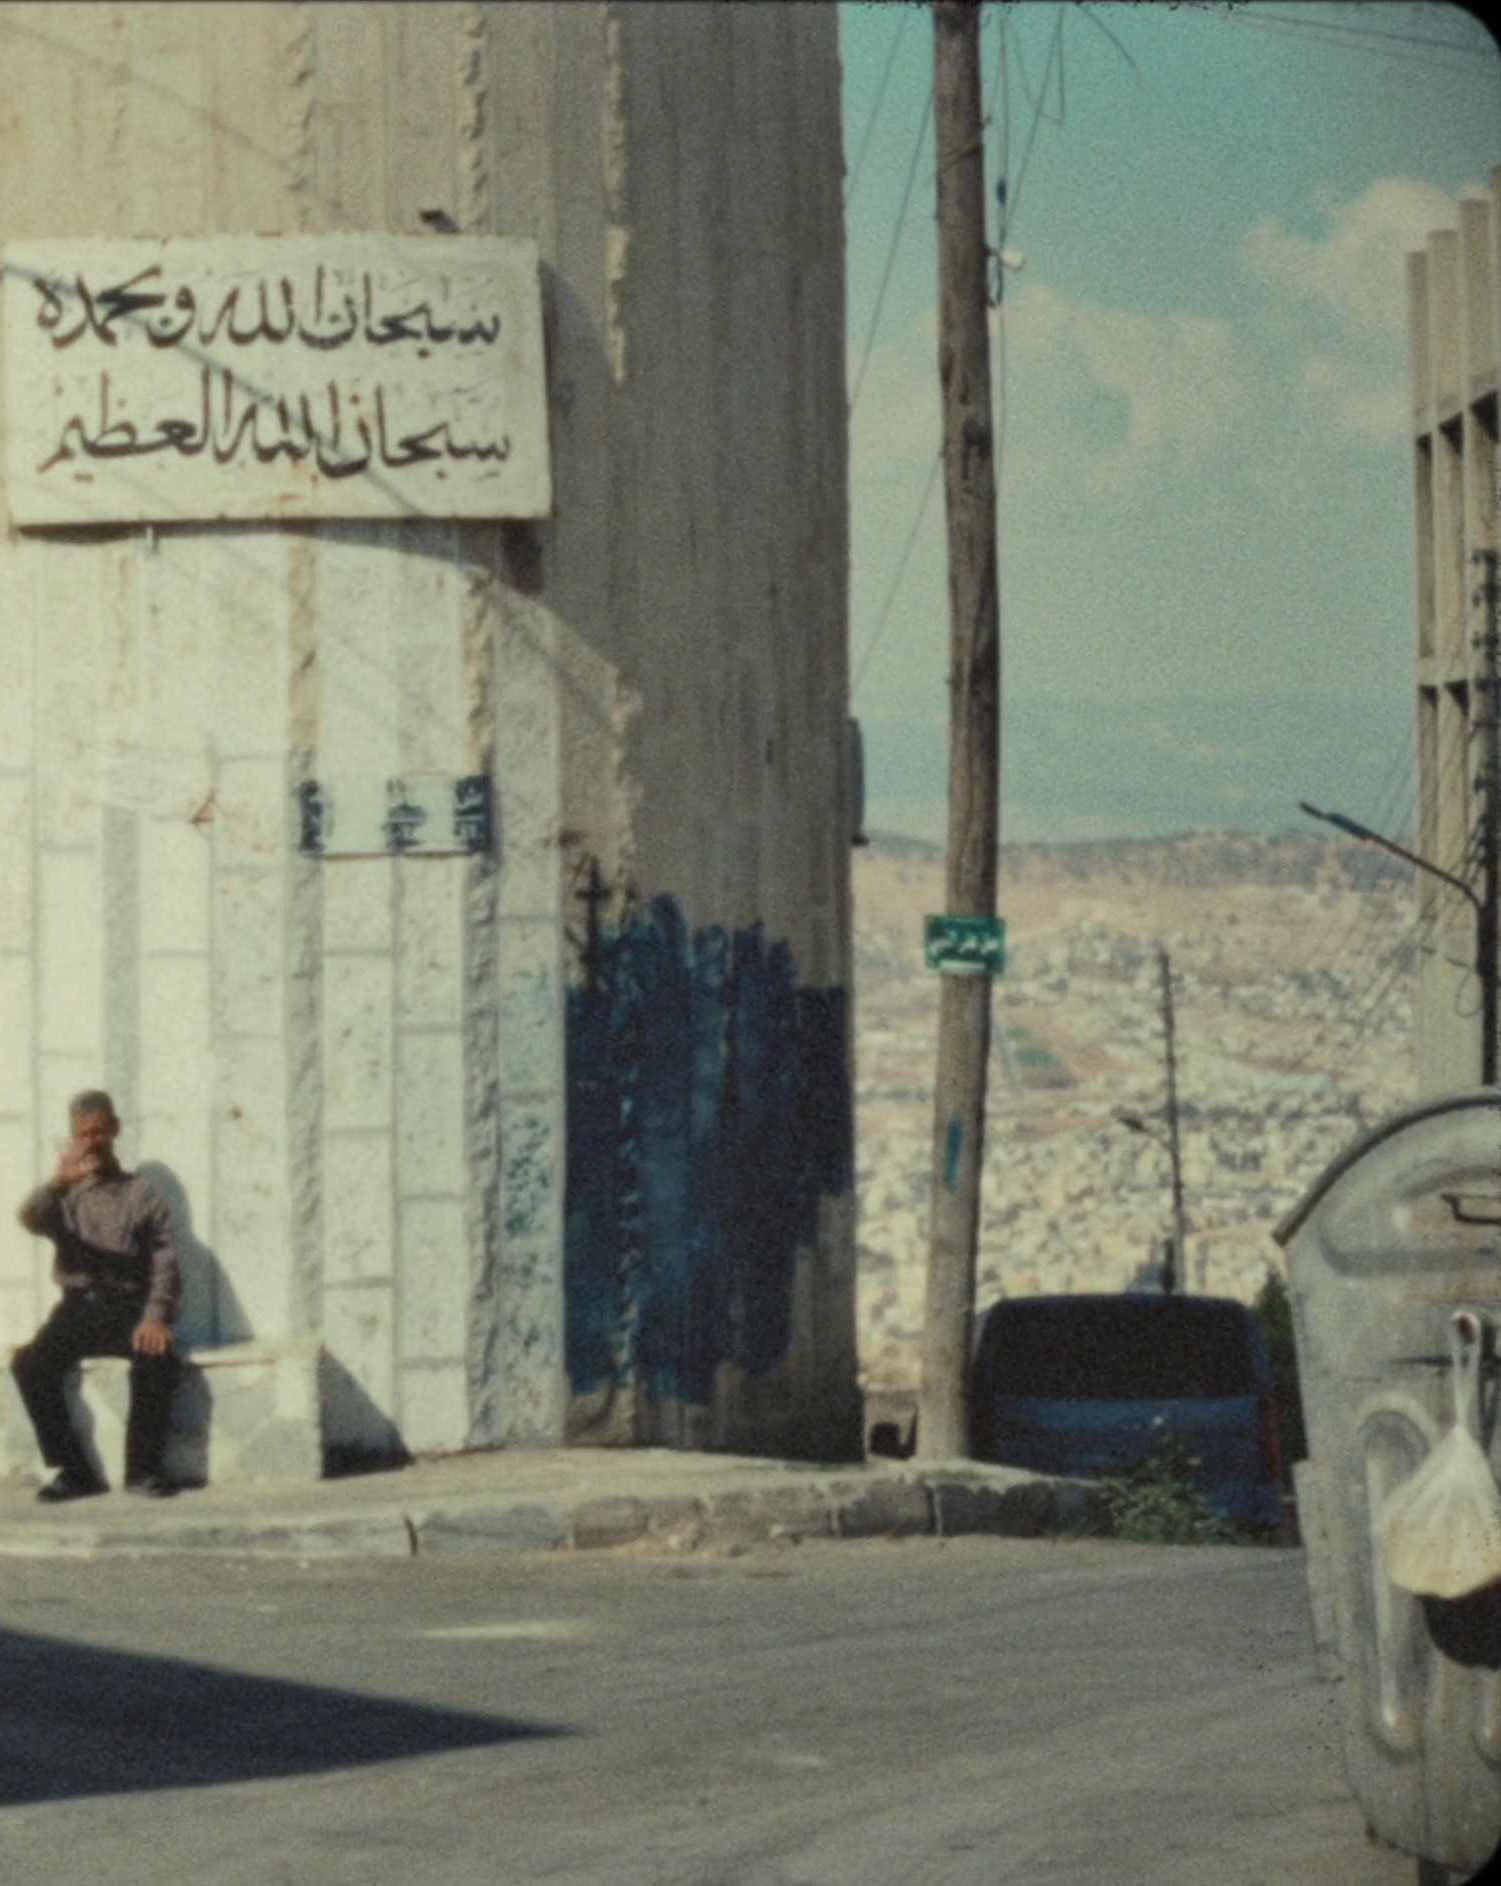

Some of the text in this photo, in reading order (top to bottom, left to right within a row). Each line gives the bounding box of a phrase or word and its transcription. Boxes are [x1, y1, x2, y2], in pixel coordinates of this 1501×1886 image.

[198, 264, 326, 346] الله
[300, 271, 501, 358] سبحان
[37, 366, 234, 482] العظيم
[316, 382, 512, 482] سبحان
